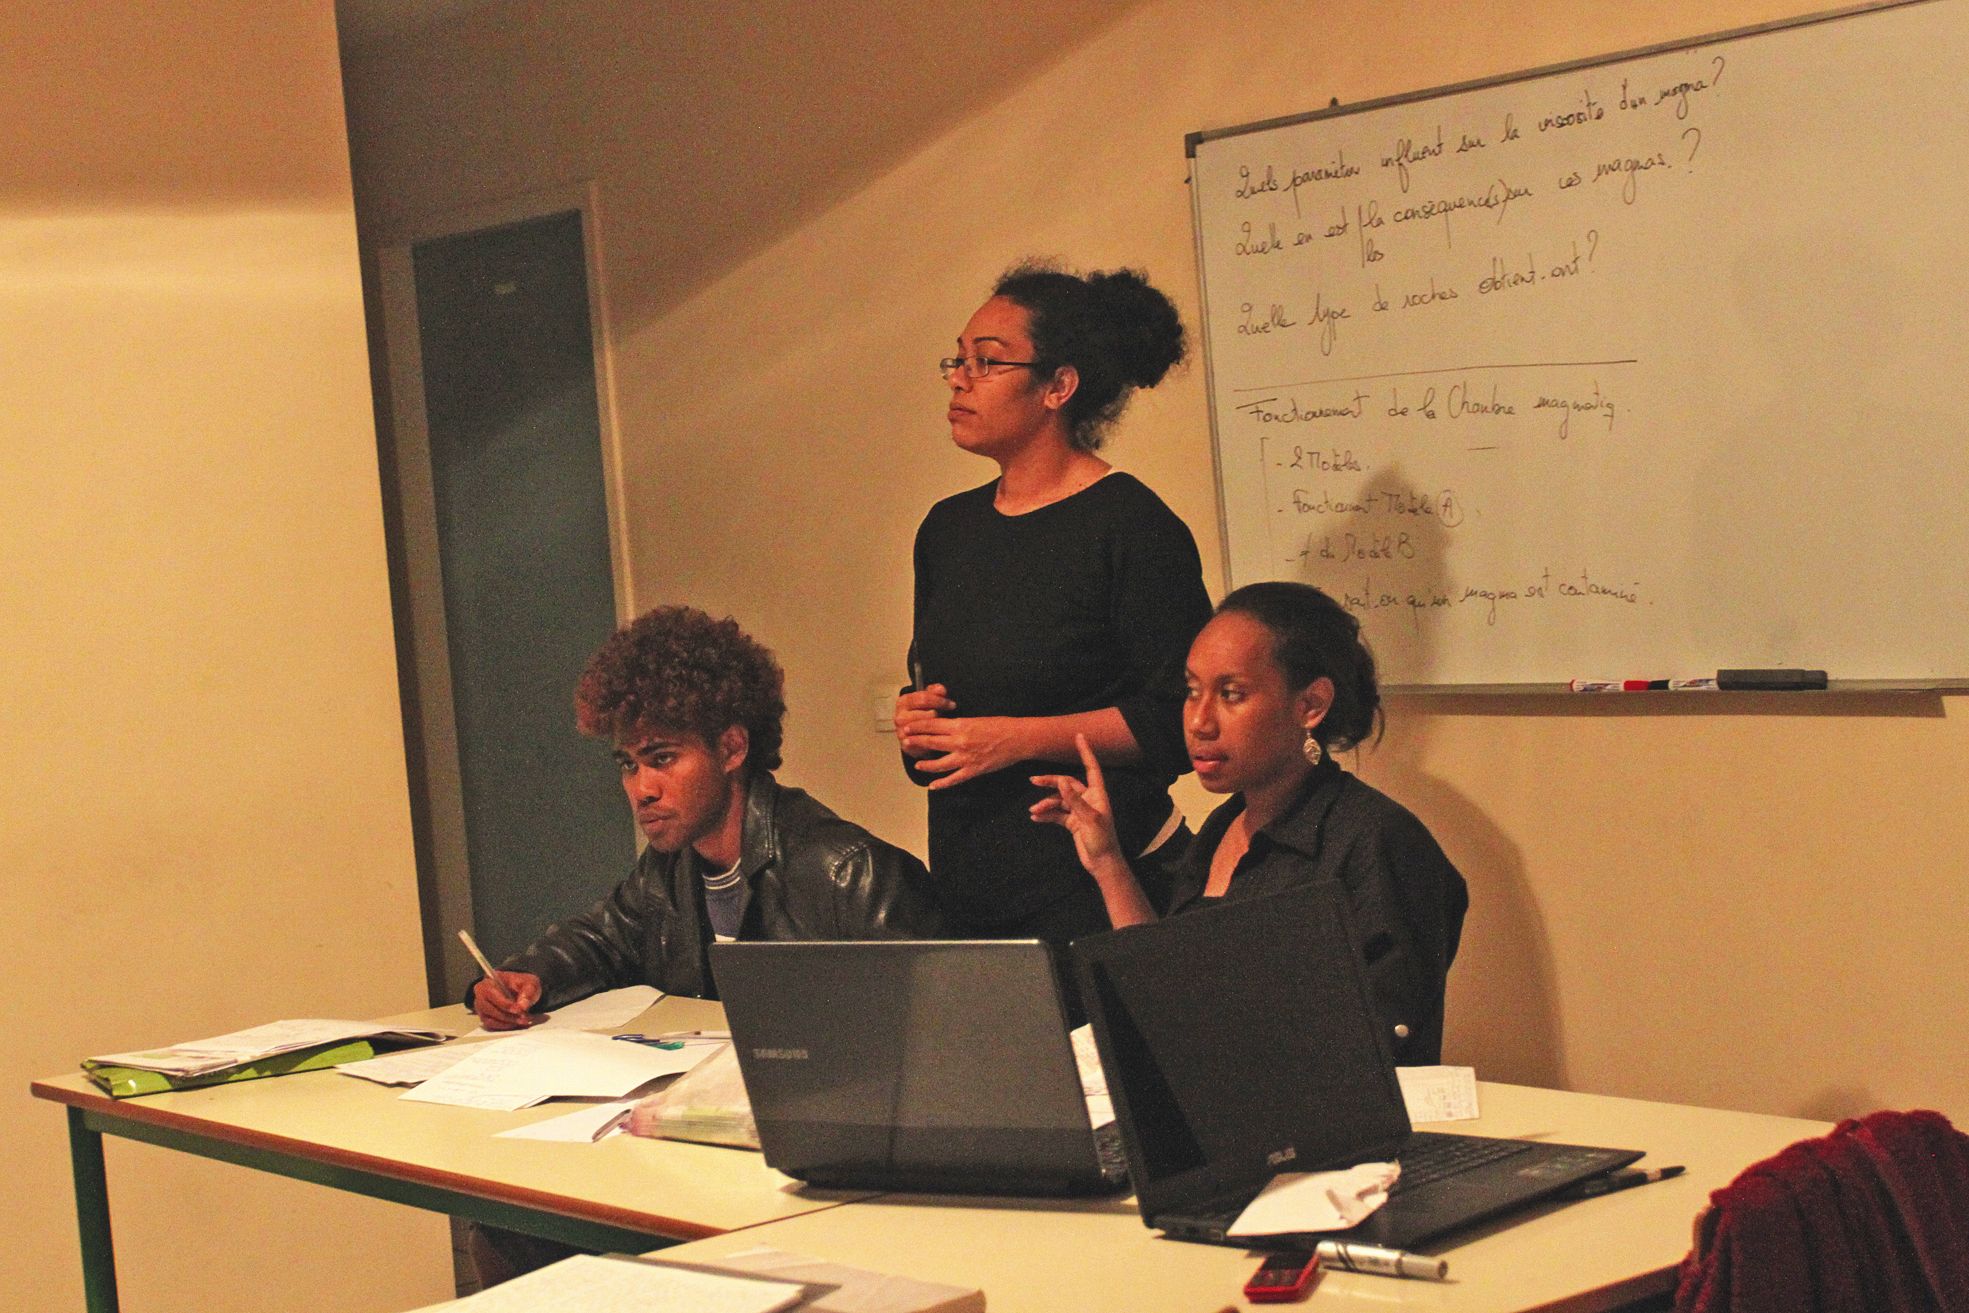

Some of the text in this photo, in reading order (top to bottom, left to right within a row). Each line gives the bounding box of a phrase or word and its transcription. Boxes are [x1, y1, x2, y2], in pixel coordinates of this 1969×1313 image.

[1293, 231, 1313, 246] en
[1237, 302, 1297, 335] Quelle
[1372, 283, 1389, 312] de
[1402, 276, 1459, 309] roches
[1388, 387, 1409, 417] de
